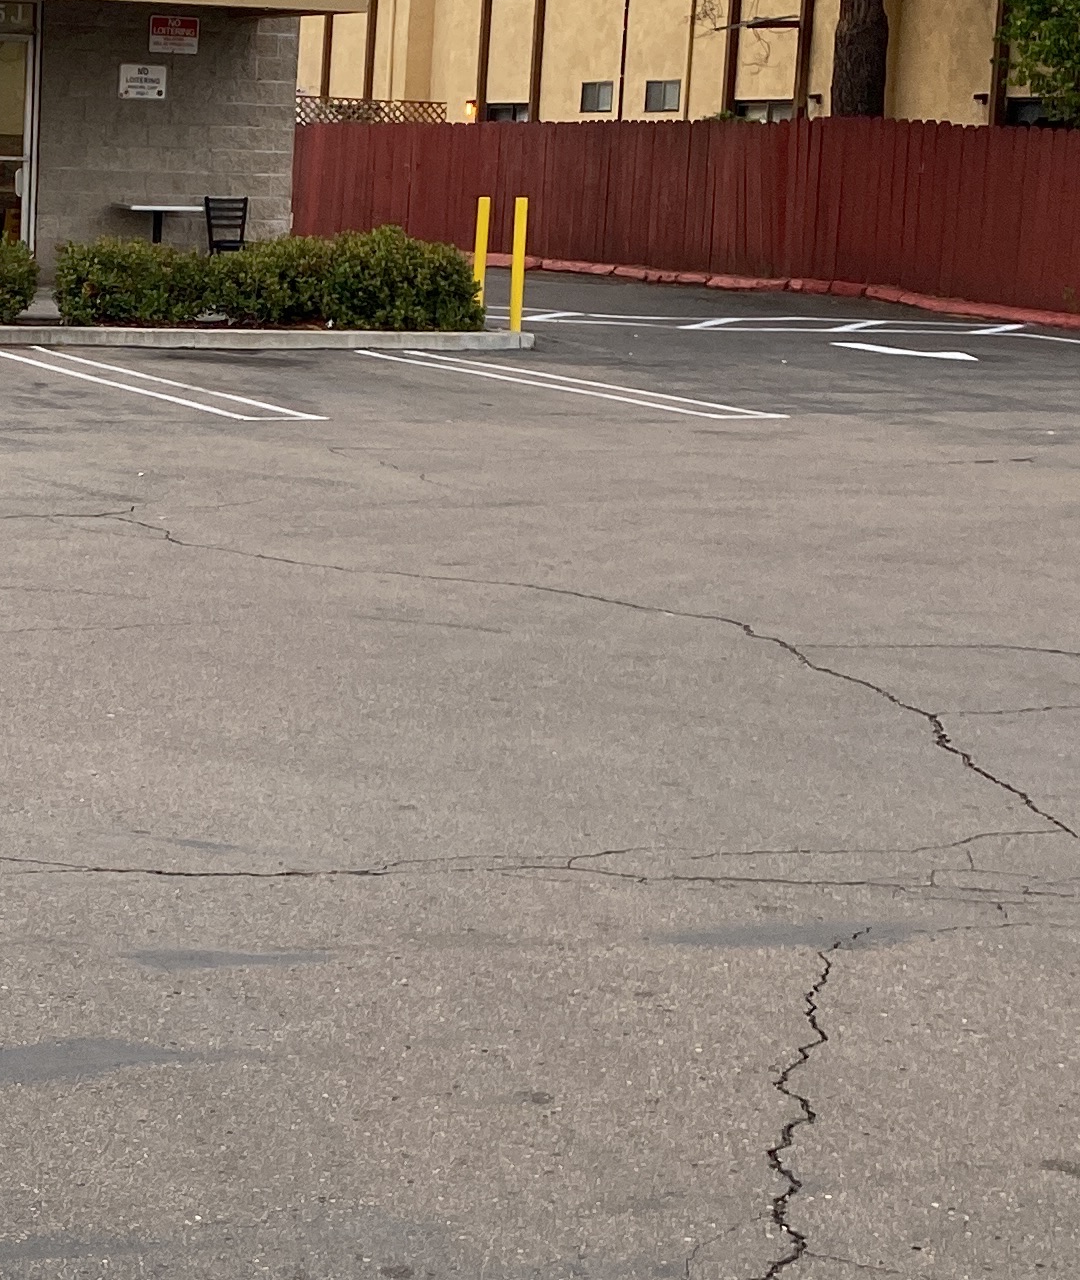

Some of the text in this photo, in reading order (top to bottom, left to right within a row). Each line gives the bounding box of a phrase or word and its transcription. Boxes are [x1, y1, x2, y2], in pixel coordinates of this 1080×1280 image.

[10, 3, 24, 23] J
[168, 19, 181, 27] NO
[153, 27, 195, 36] LOITERING
[137, 67, 149, 75] NO
